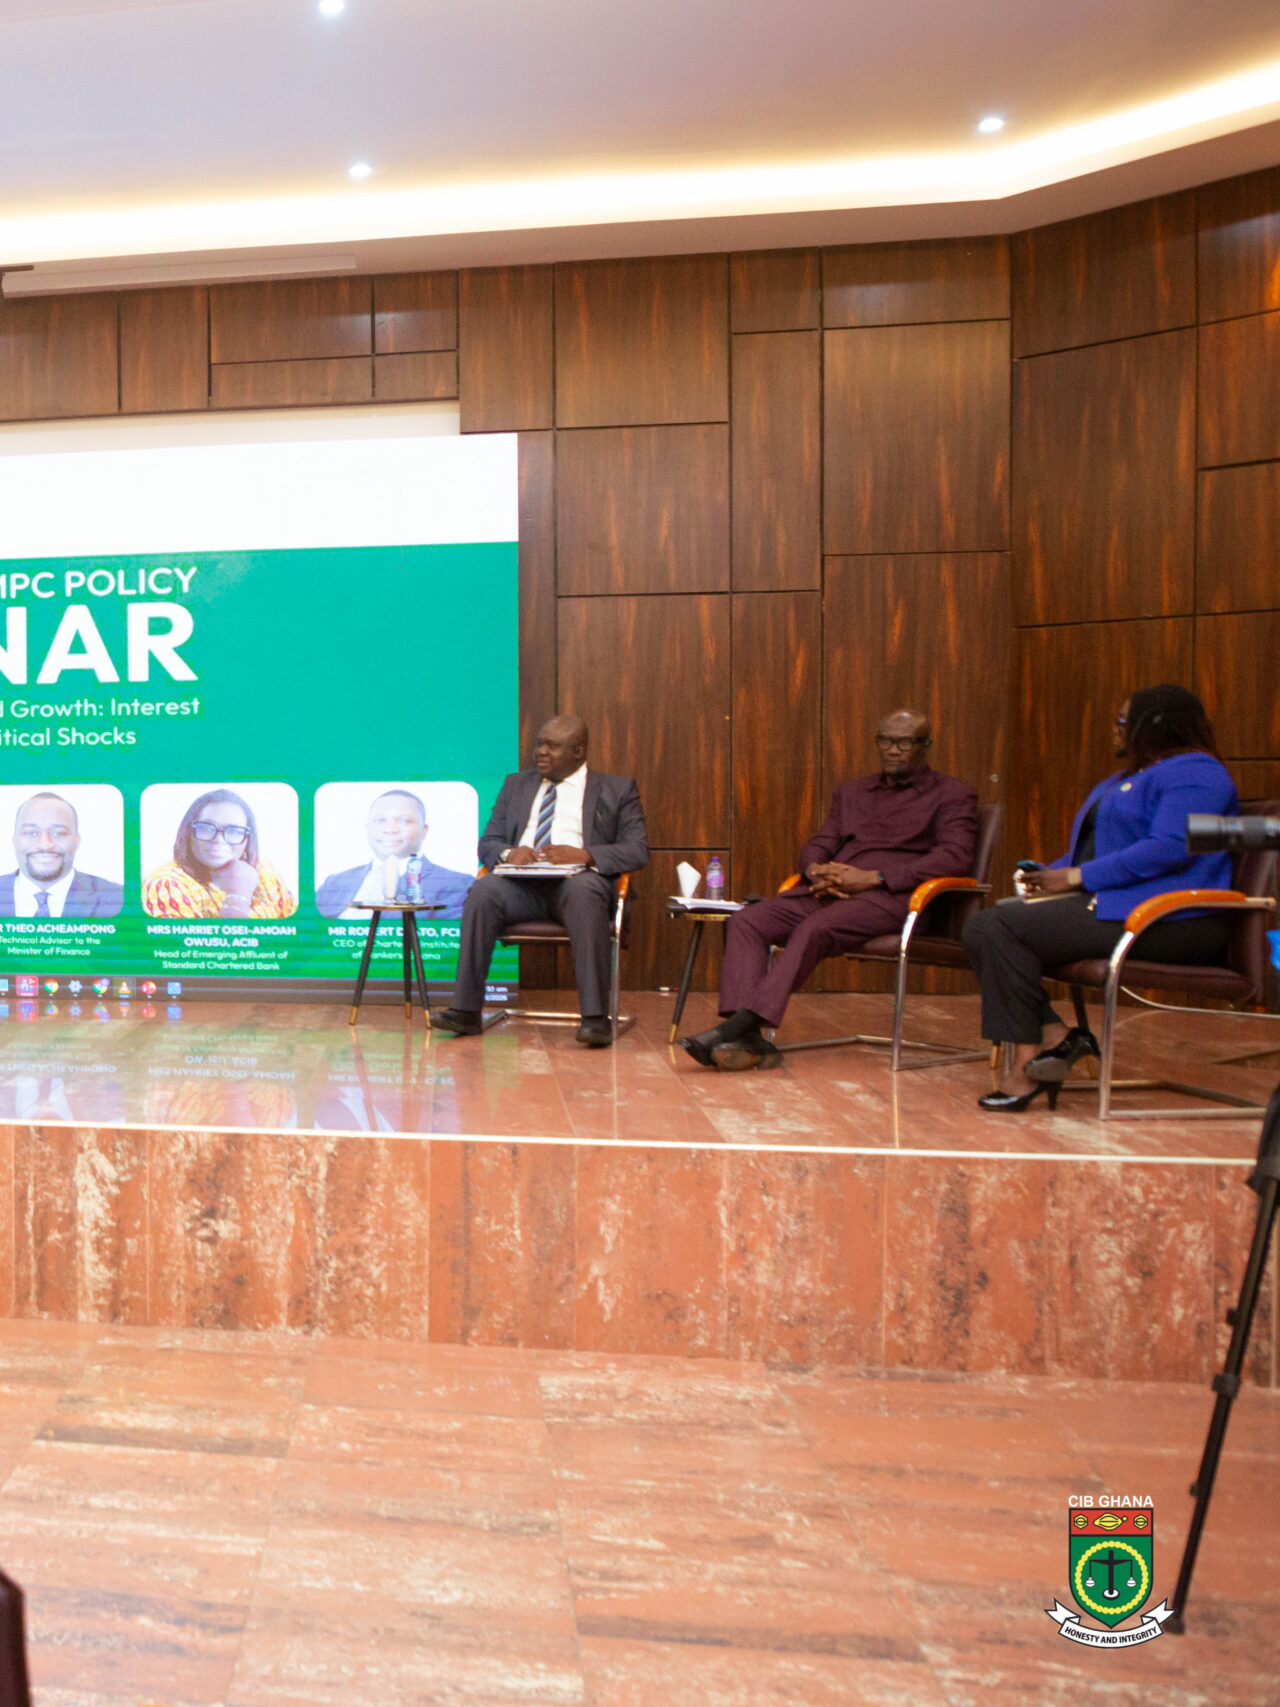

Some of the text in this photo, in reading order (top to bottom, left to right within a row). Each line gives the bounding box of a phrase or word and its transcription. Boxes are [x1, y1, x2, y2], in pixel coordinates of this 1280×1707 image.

[64, 566, 198, 597] POLICY
[10, 699, 104, 718] Growth:
[110, 697, 200, 716] Interest
[57, 725, 137, 746] Shocks
[5, 923, 35, 933] THEO
[37, 924, 116, 934] ACHEAMPONG
[146, 925, 297, 935] MRS HARRIET OSEI-AMOAH
[328, 926, 346, 936] MR
[40, 936, 72, 944] Advisor
[86, 937, 101, 945] the
[184, 937, 259, 947] OWUSU, ACIB
[333, 939, 355, 948] CEO
[7, 947, 91, 955] Minister of Finance
[154, 950, 288, 960] Head of Emerging Affluent of
[162, 961, 279, 970] Standard Chartered Bank
